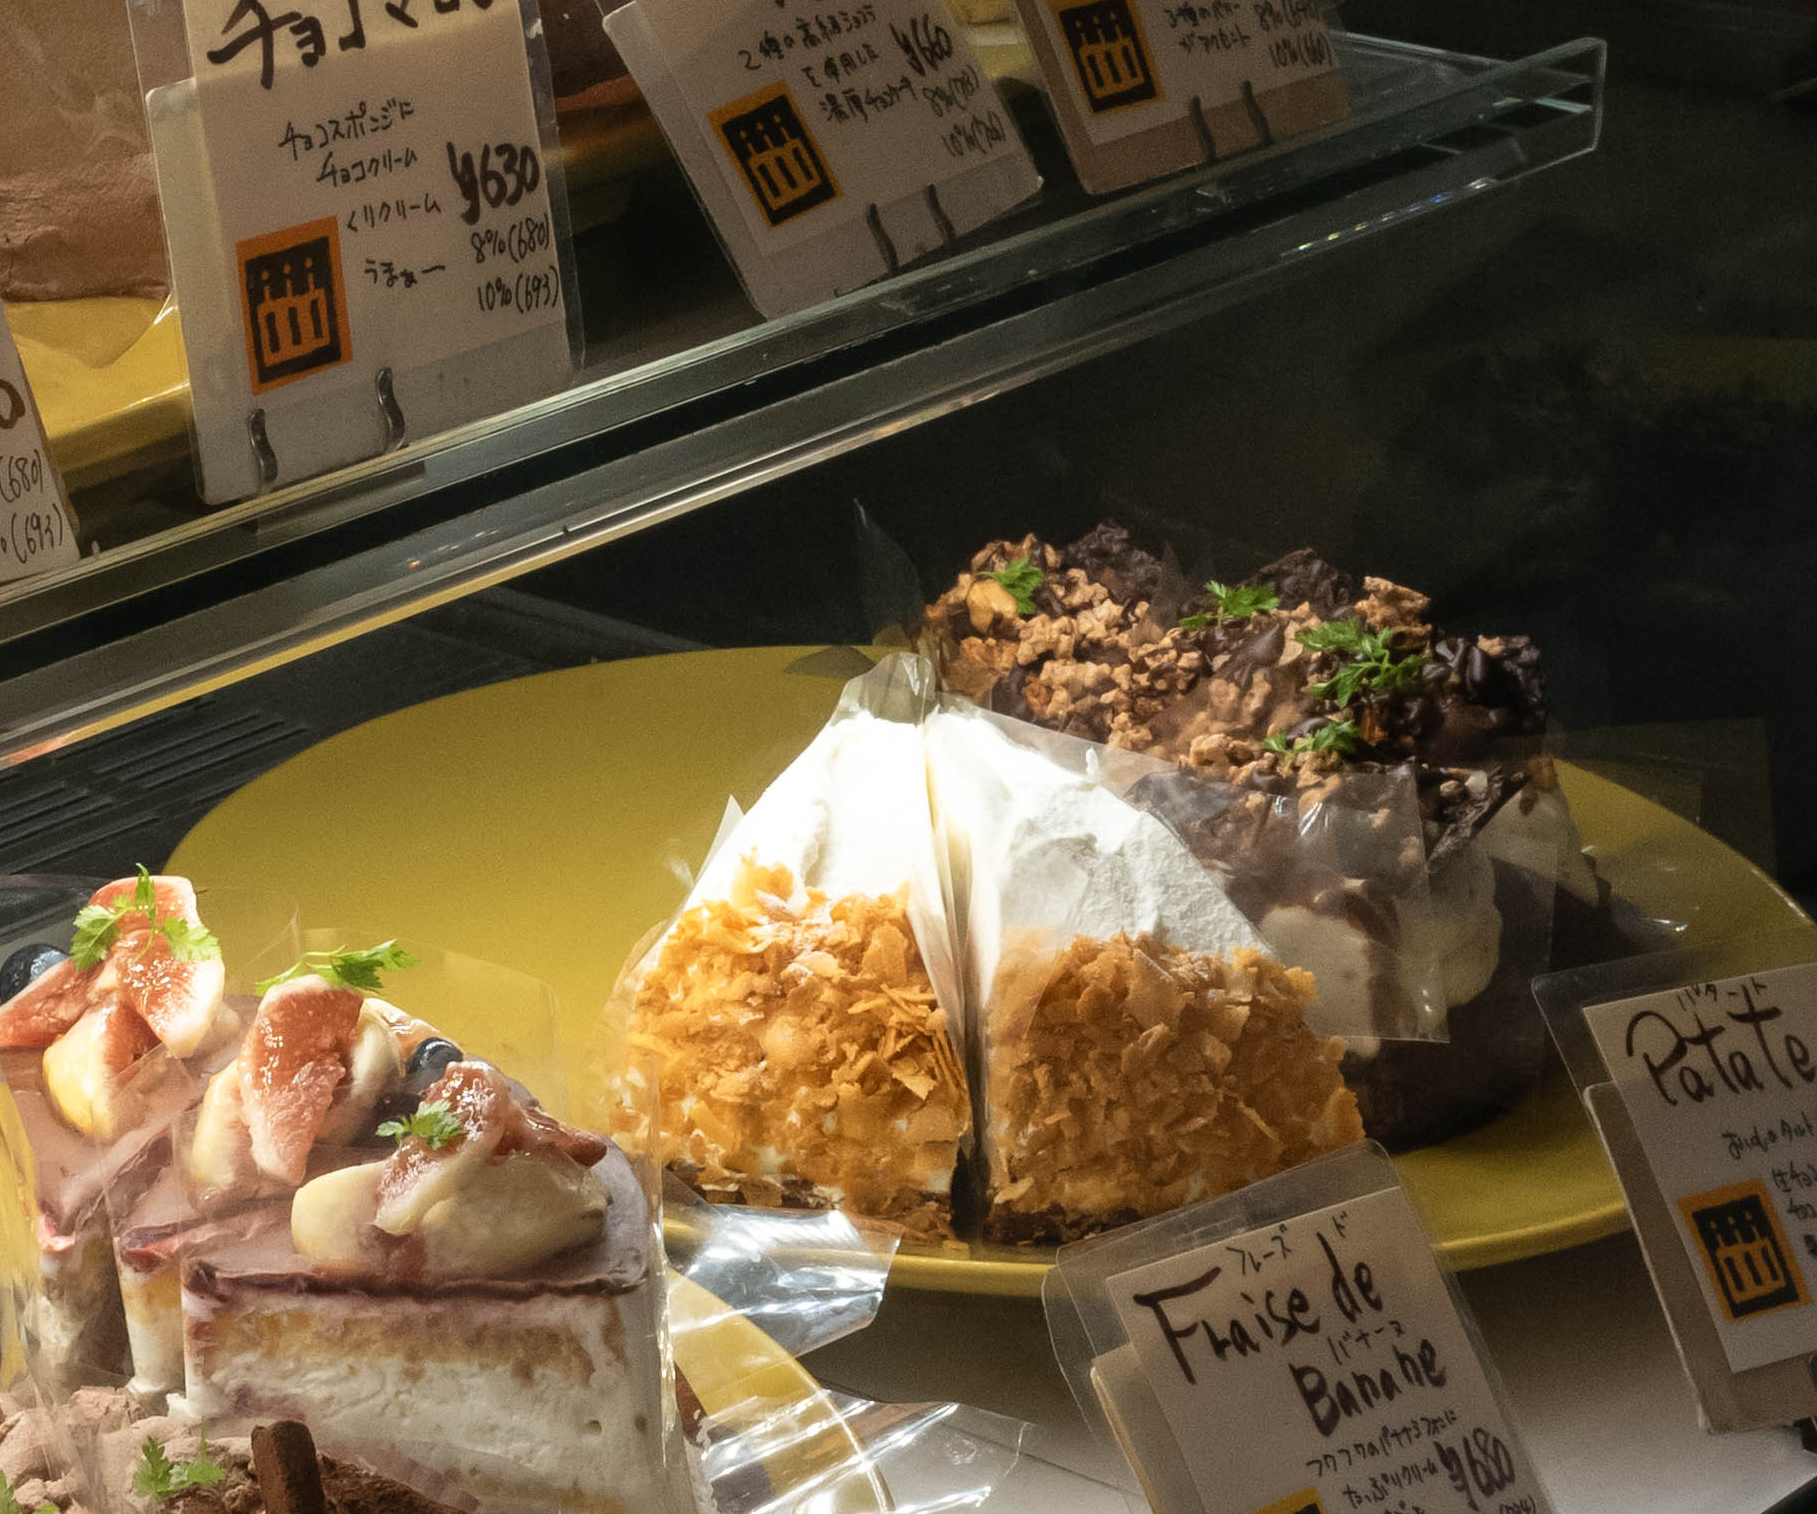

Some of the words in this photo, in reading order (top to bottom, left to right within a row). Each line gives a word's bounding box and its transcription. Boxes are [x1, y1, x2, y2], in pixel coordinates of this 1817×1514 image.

[314, 147, 418, 189] チョコクリーム
[446, 140, 541, 225] ¥630
[470, 213, 551, 265] 8%(680)
[477, 264, 560, 313] 10%(693)
[1626, 983, 1817, 1107] Patate
[1133, 1265, 1321, 1386] Fraise
[1316, 1231, 1385, 1323] de
[1288, 1338, 1448, 1438] Banane
